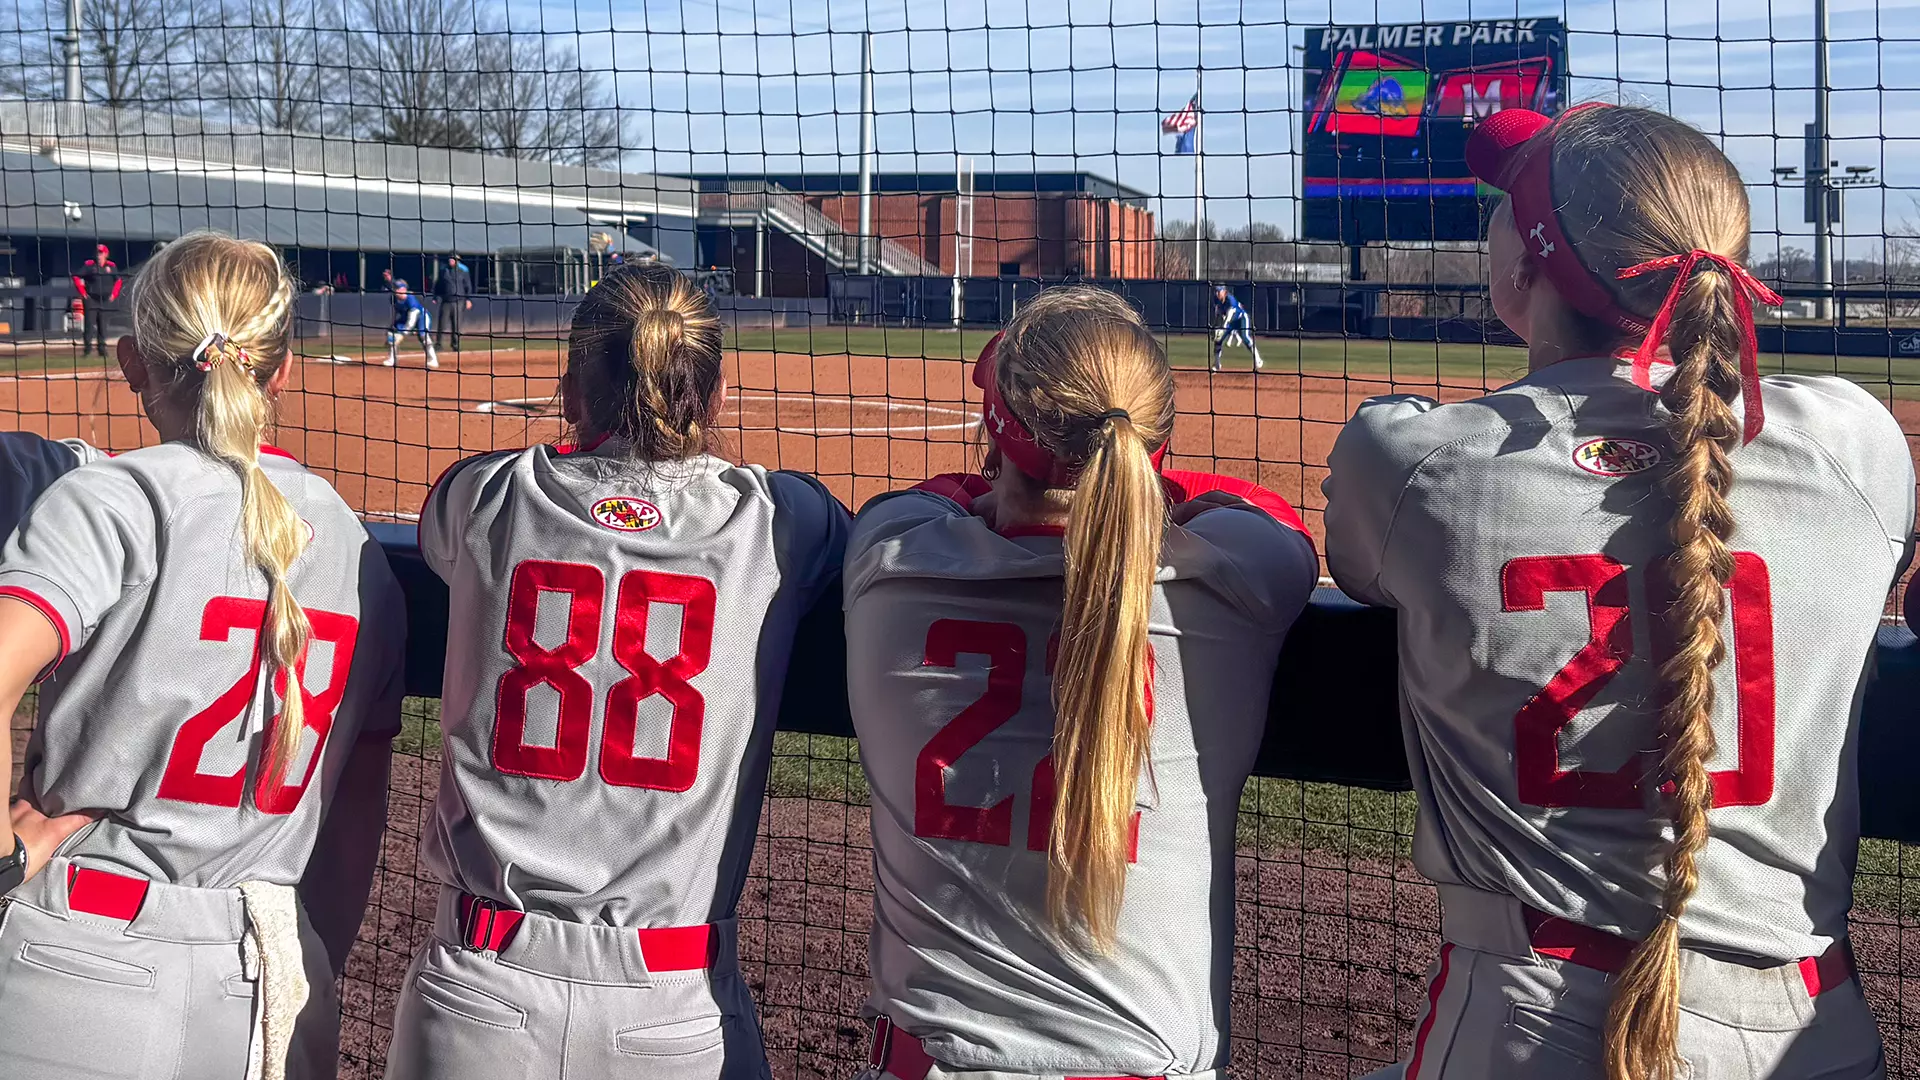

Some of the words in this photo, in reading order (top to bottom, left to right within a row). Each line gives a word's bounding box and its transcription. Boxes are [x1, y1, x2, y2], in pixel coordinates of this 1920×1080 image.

[1320, 24, 1443, 51] PALMER
[1452, 18, 1539, 46] PARK
[1462, 79, 1503, 122] M
[1616, 315, 1648, 334] TERR
[156, 596, 359, 814] 28
[492, 559, 717, 792] 88
[1502, 551, 1776, 808] 20
